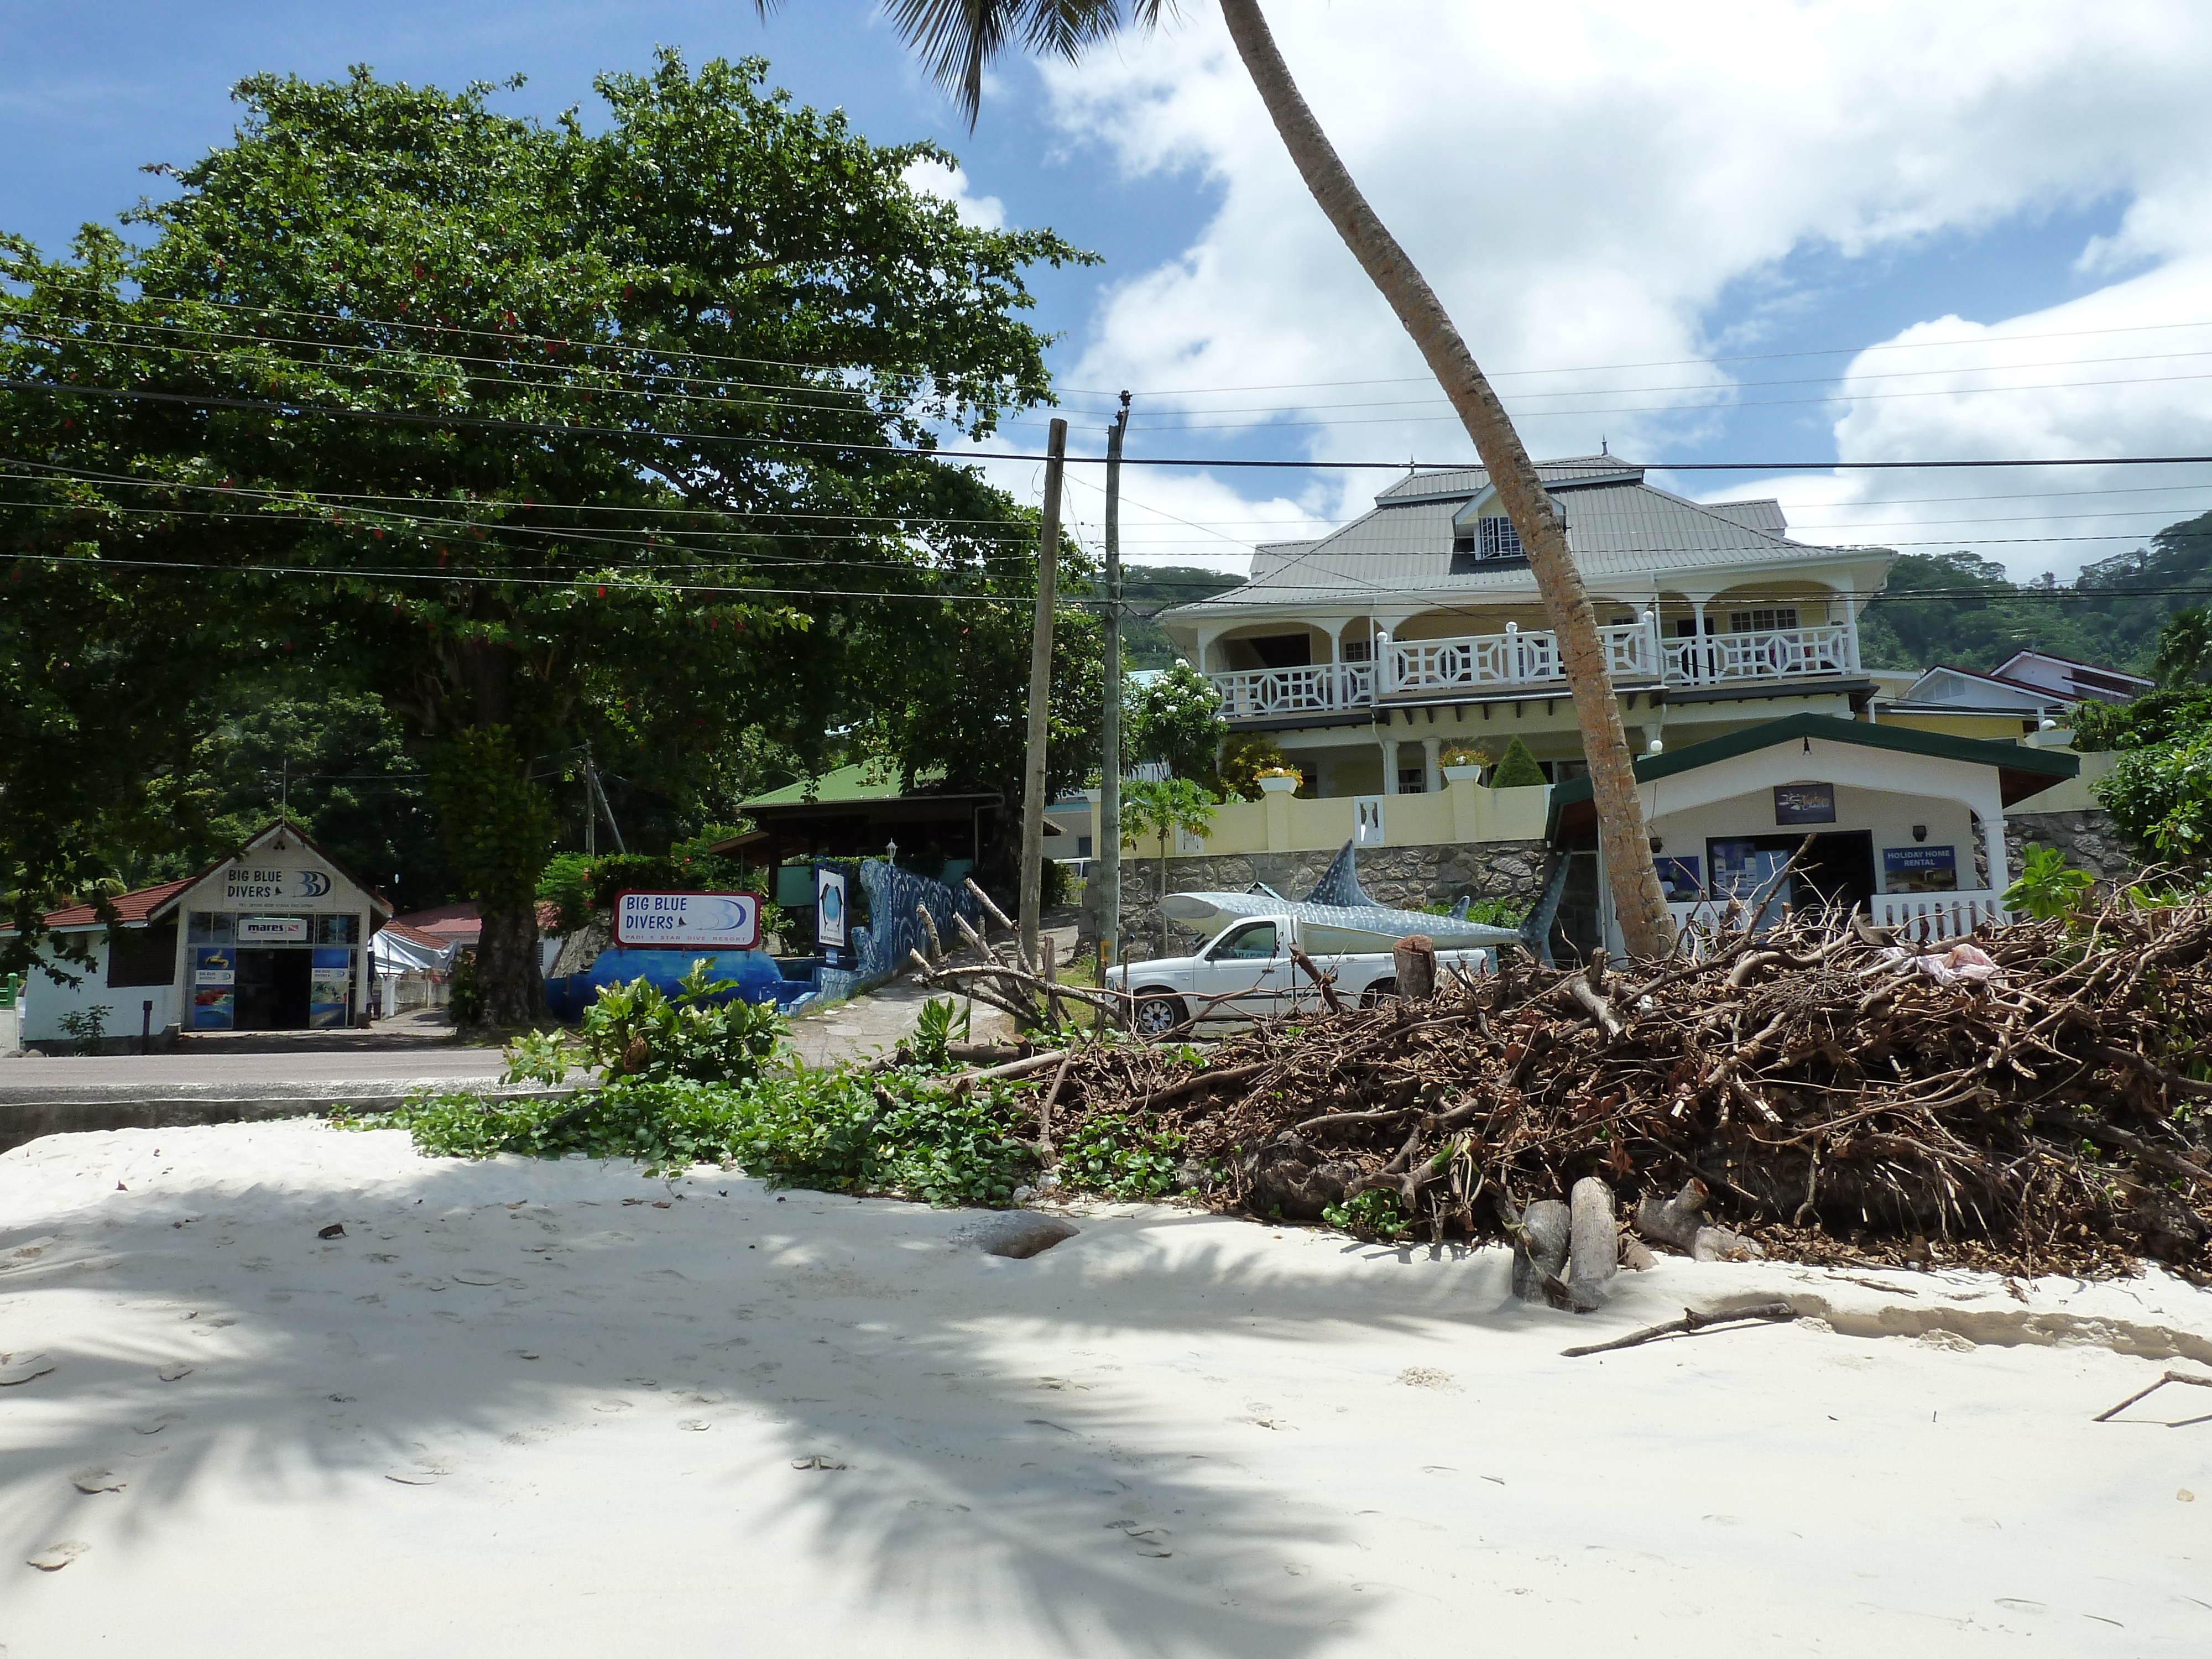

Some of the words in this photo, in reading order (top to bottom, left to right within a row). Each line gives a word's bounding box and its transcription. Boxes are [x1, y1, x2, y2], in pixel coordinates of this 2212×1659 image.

[228, 870, 248, 881] BIG
[254, 870, 281, 881] BLUE
[228, 886, 270, 898] DIVERS
[627, 897, 649, 910] BIG
[655, 898, 687, 910] BLUE
[626, 915, 673, 929] DIVERS
